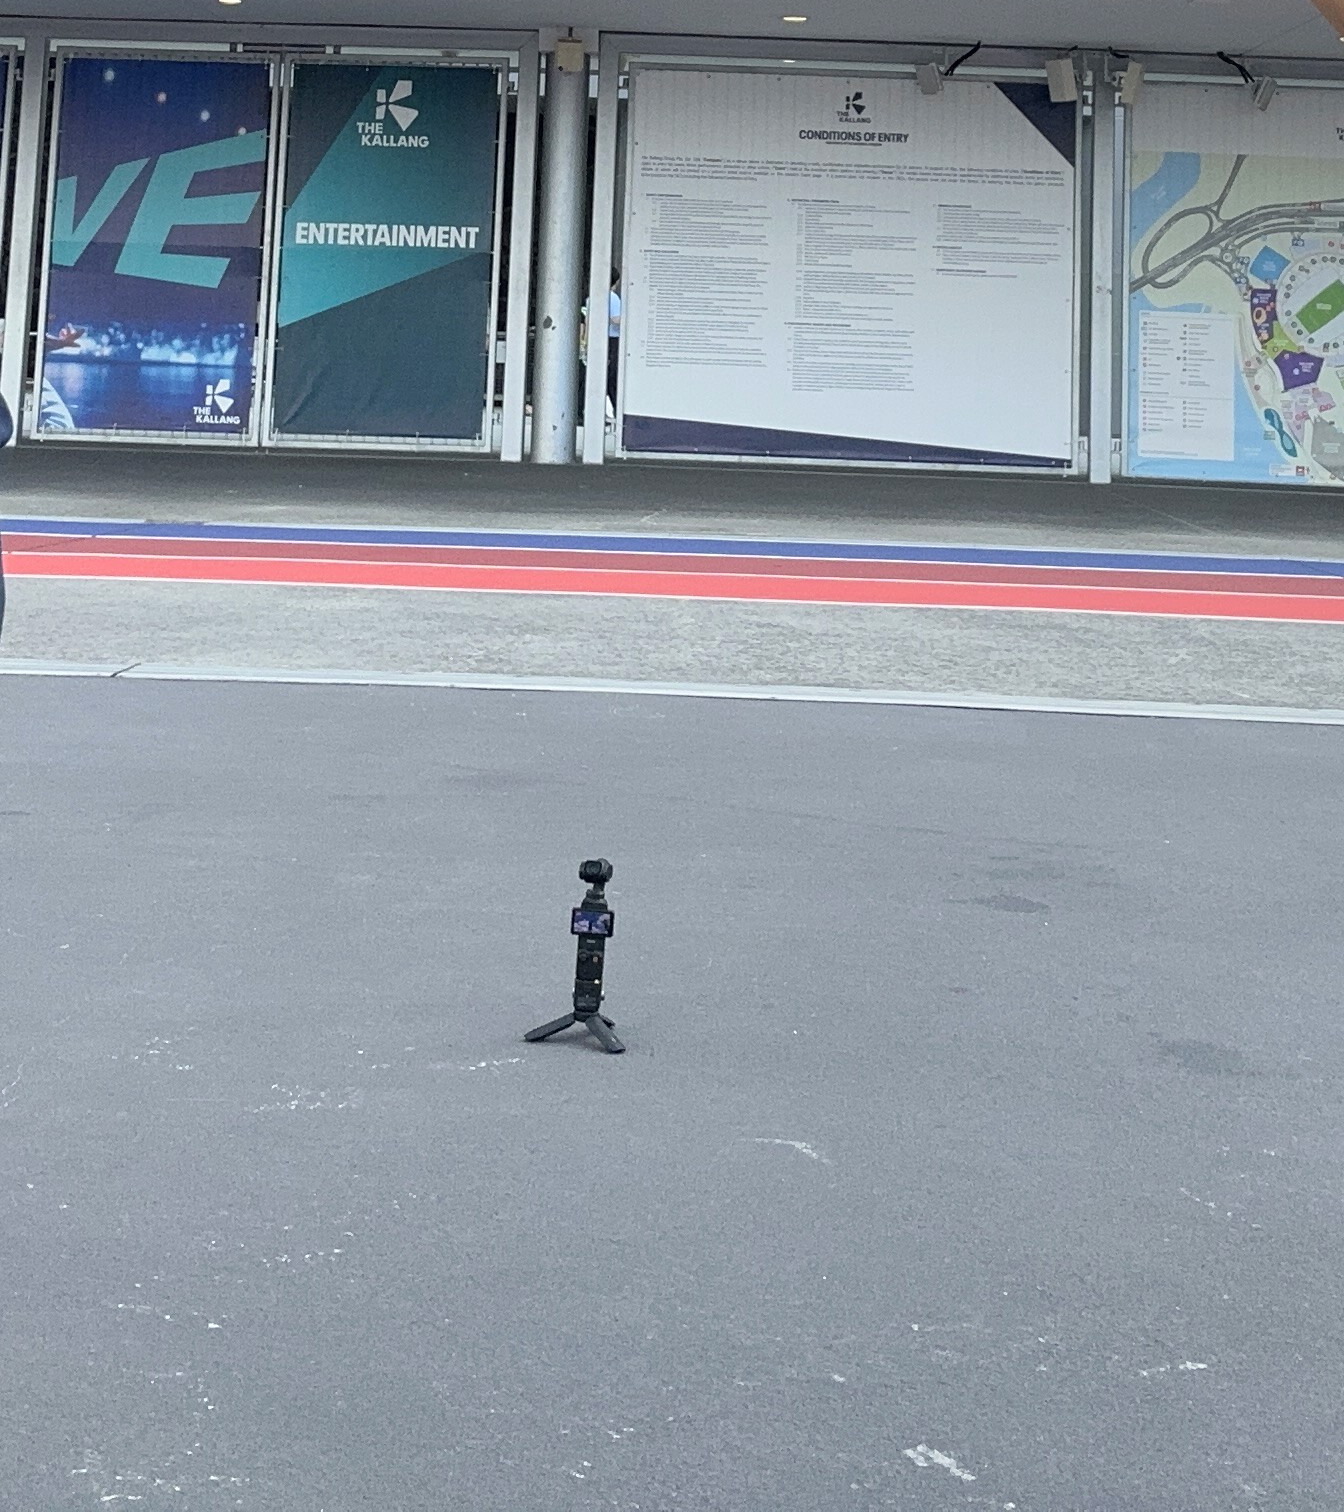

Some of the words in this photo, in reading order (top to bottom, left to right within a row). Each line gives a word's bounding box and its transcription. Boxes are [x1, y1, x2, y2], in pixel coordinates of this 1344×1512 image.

[357, 121, 383, 134] THE
[361, 135, 430, 148] KALLANG
[799, 129, 862, 142] CONDITIONS
[863, 132, 877, 142] OF
[877, 133, 909, 143] ENTRY
[295, 222, 480, 249] ENTERTAINMENT
[193, 406, 211, 415] THE
[196, 415, 241, 424] KALLANG
